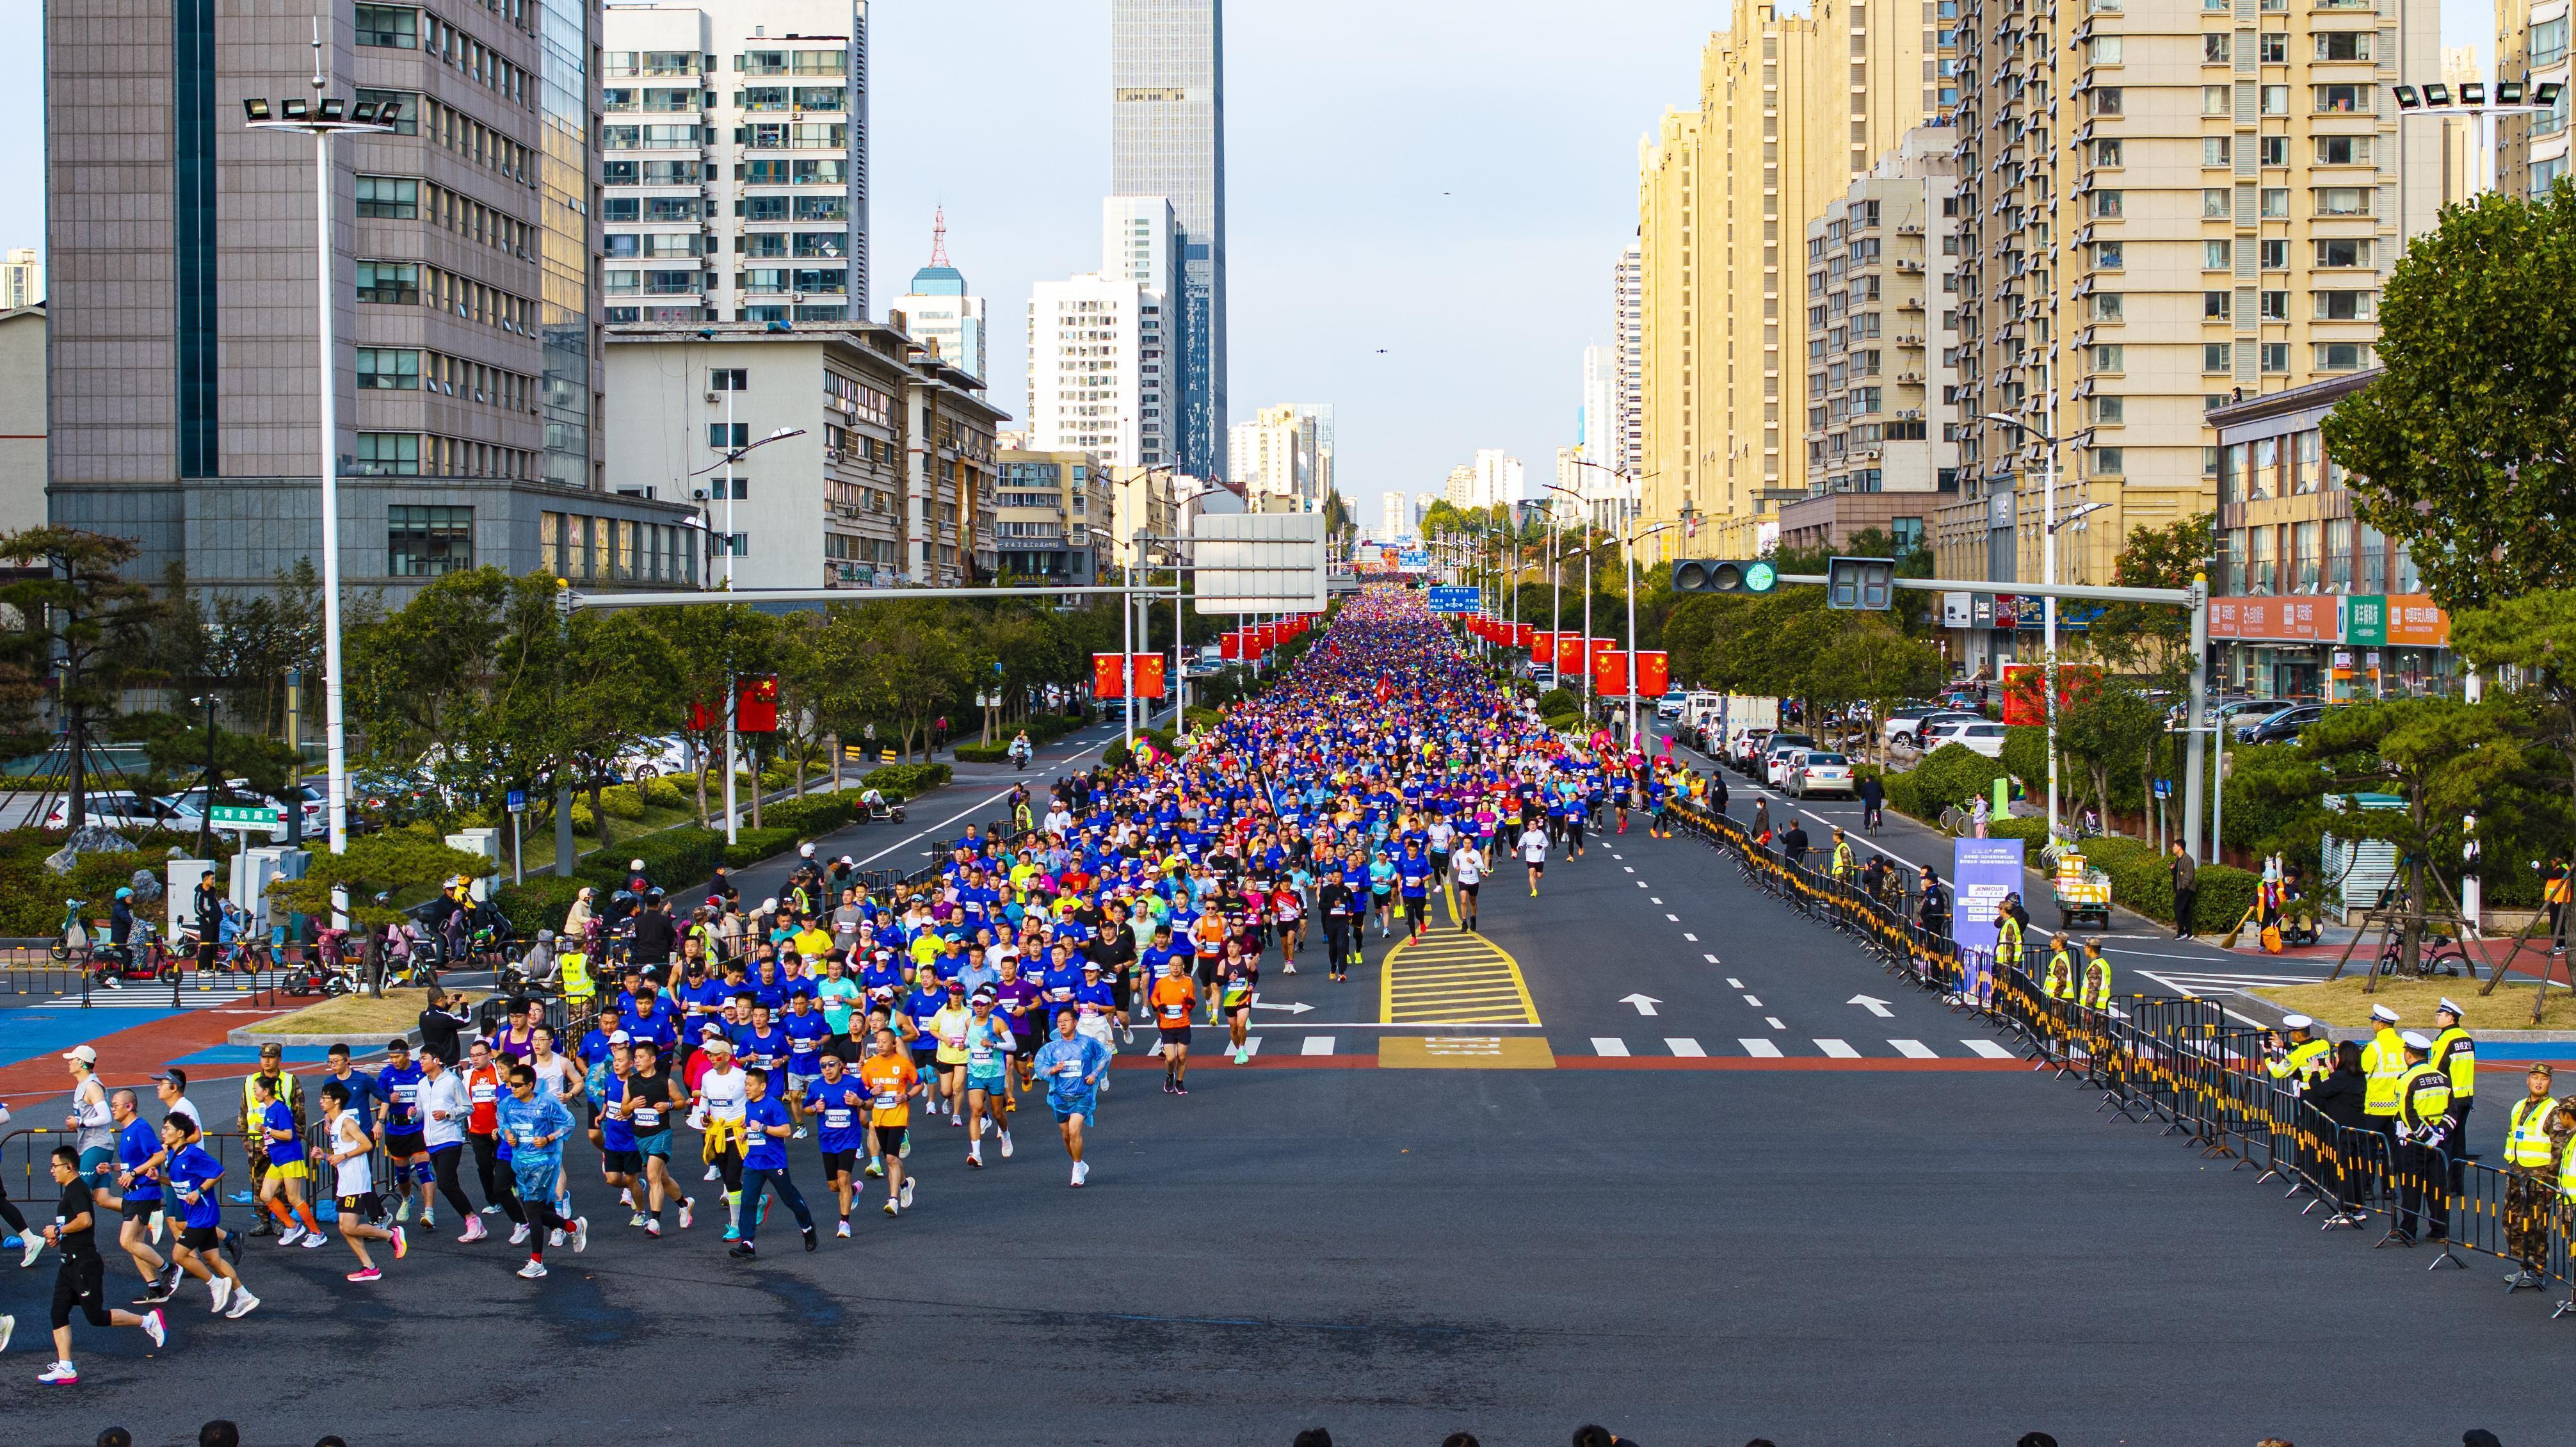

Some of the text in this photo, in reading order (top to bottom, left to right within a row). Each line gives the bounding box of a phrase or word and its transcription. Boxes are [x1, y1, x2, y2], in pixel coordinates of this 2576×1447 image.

[2222, 605, 2235, 620] 平安银行
[2297, 604, 2312, 621] 平安银行
[2405, 608, 2438, 623] 中国平安人寿保险
[224, 809, 263, 820] 青岛路
[2419, 1076, 2445, 1086] 日照交警
[344, 1195, 356, 1208] 61
